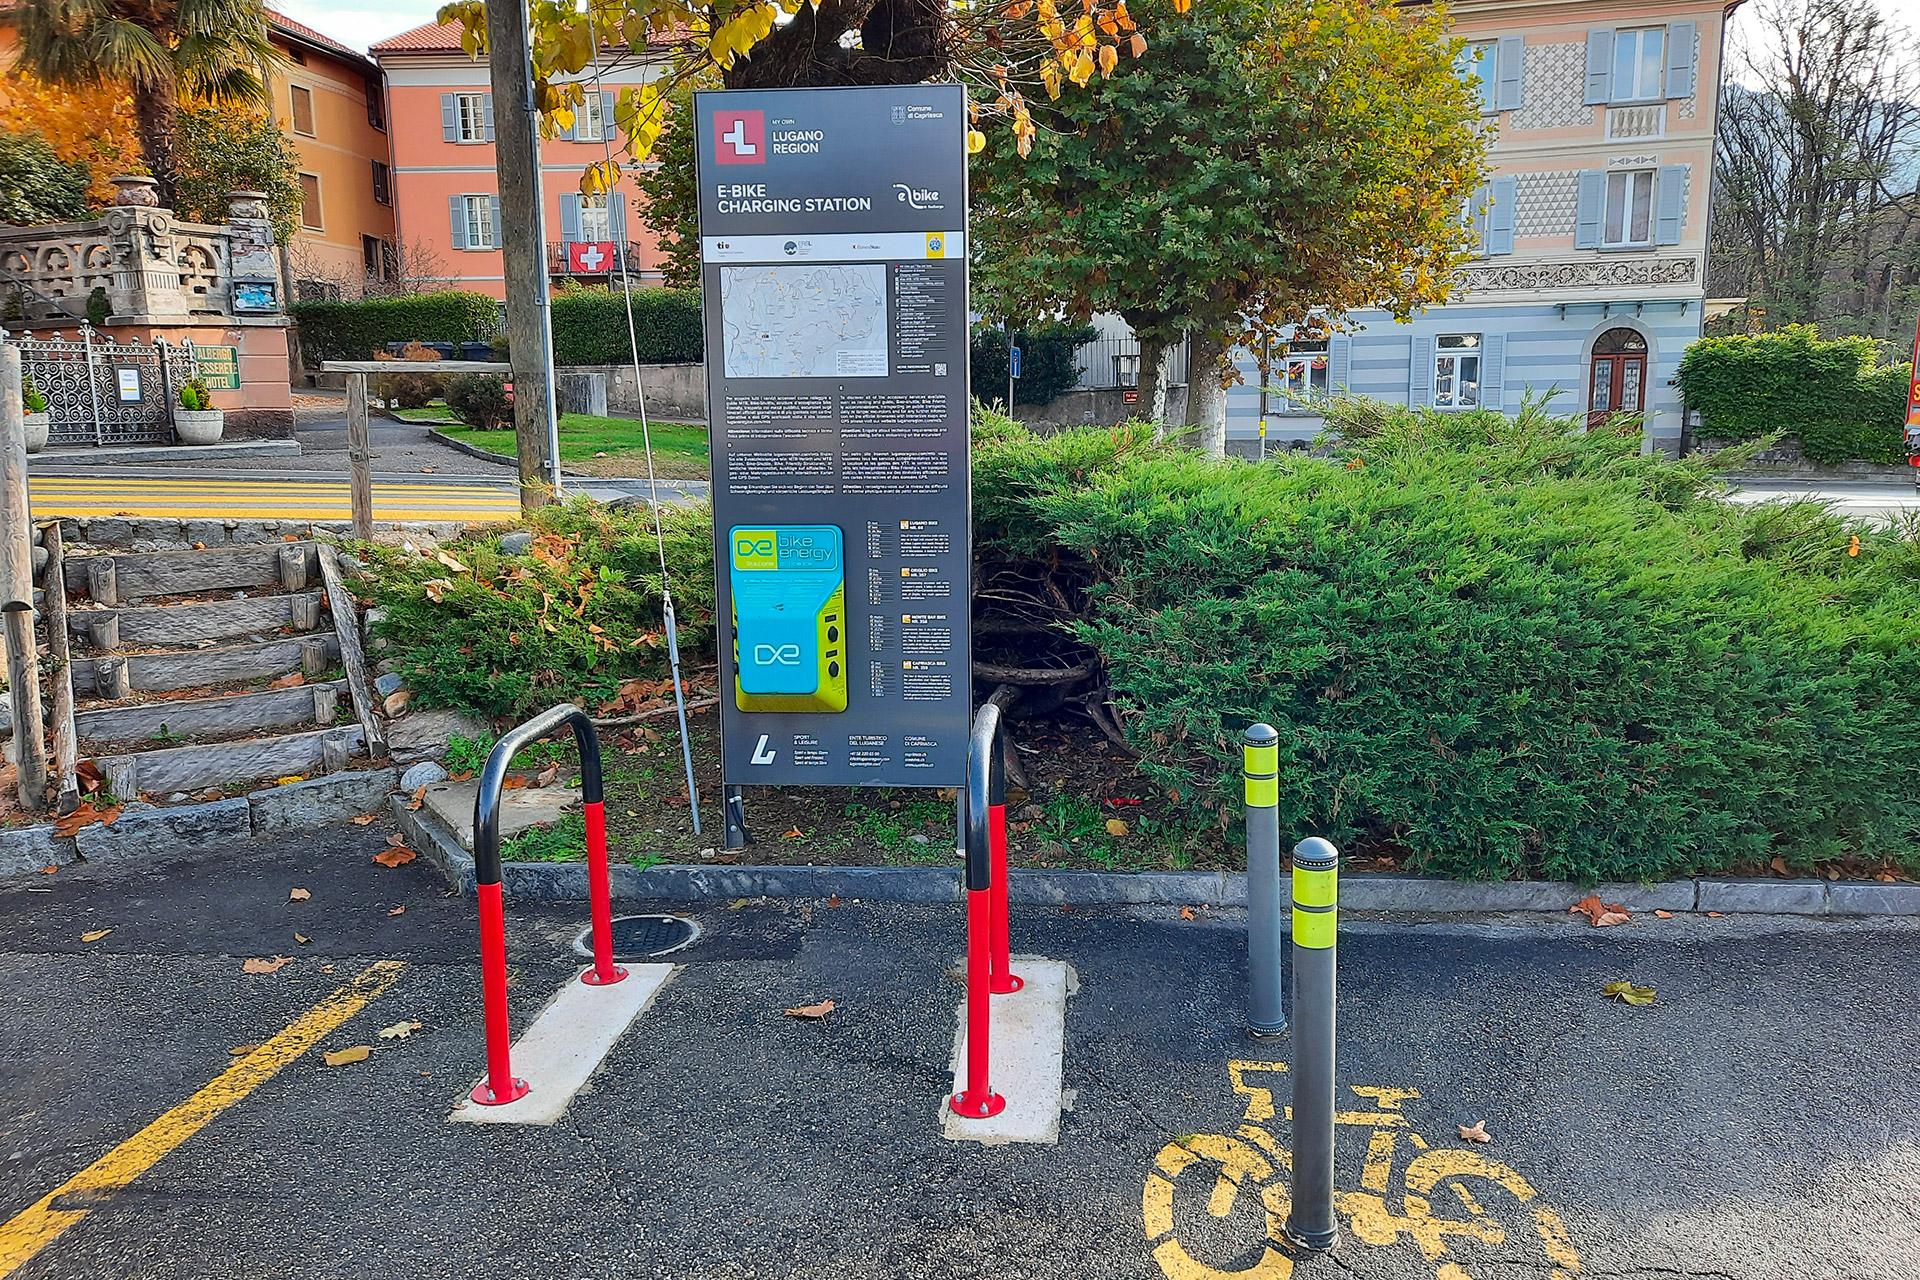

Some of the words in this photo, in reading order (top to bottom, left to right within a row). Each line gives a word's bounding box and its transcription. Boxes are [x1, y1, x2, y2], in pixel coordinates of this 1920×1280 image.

[772, 130, 824, 142] LUGANO
[773, 142, 819, 154] REGION
[717, 184, 766, 198] E-BIKE
[717, 199, 801, 214] CHARGING
[805, 197, 871, 212] STATION
[197, 347, 232, 360] ALBERGO
[206, 376, 231, 389] HOTEL
[778, 535, 813, 547] bike
[779, 547, 833, 561] energy
